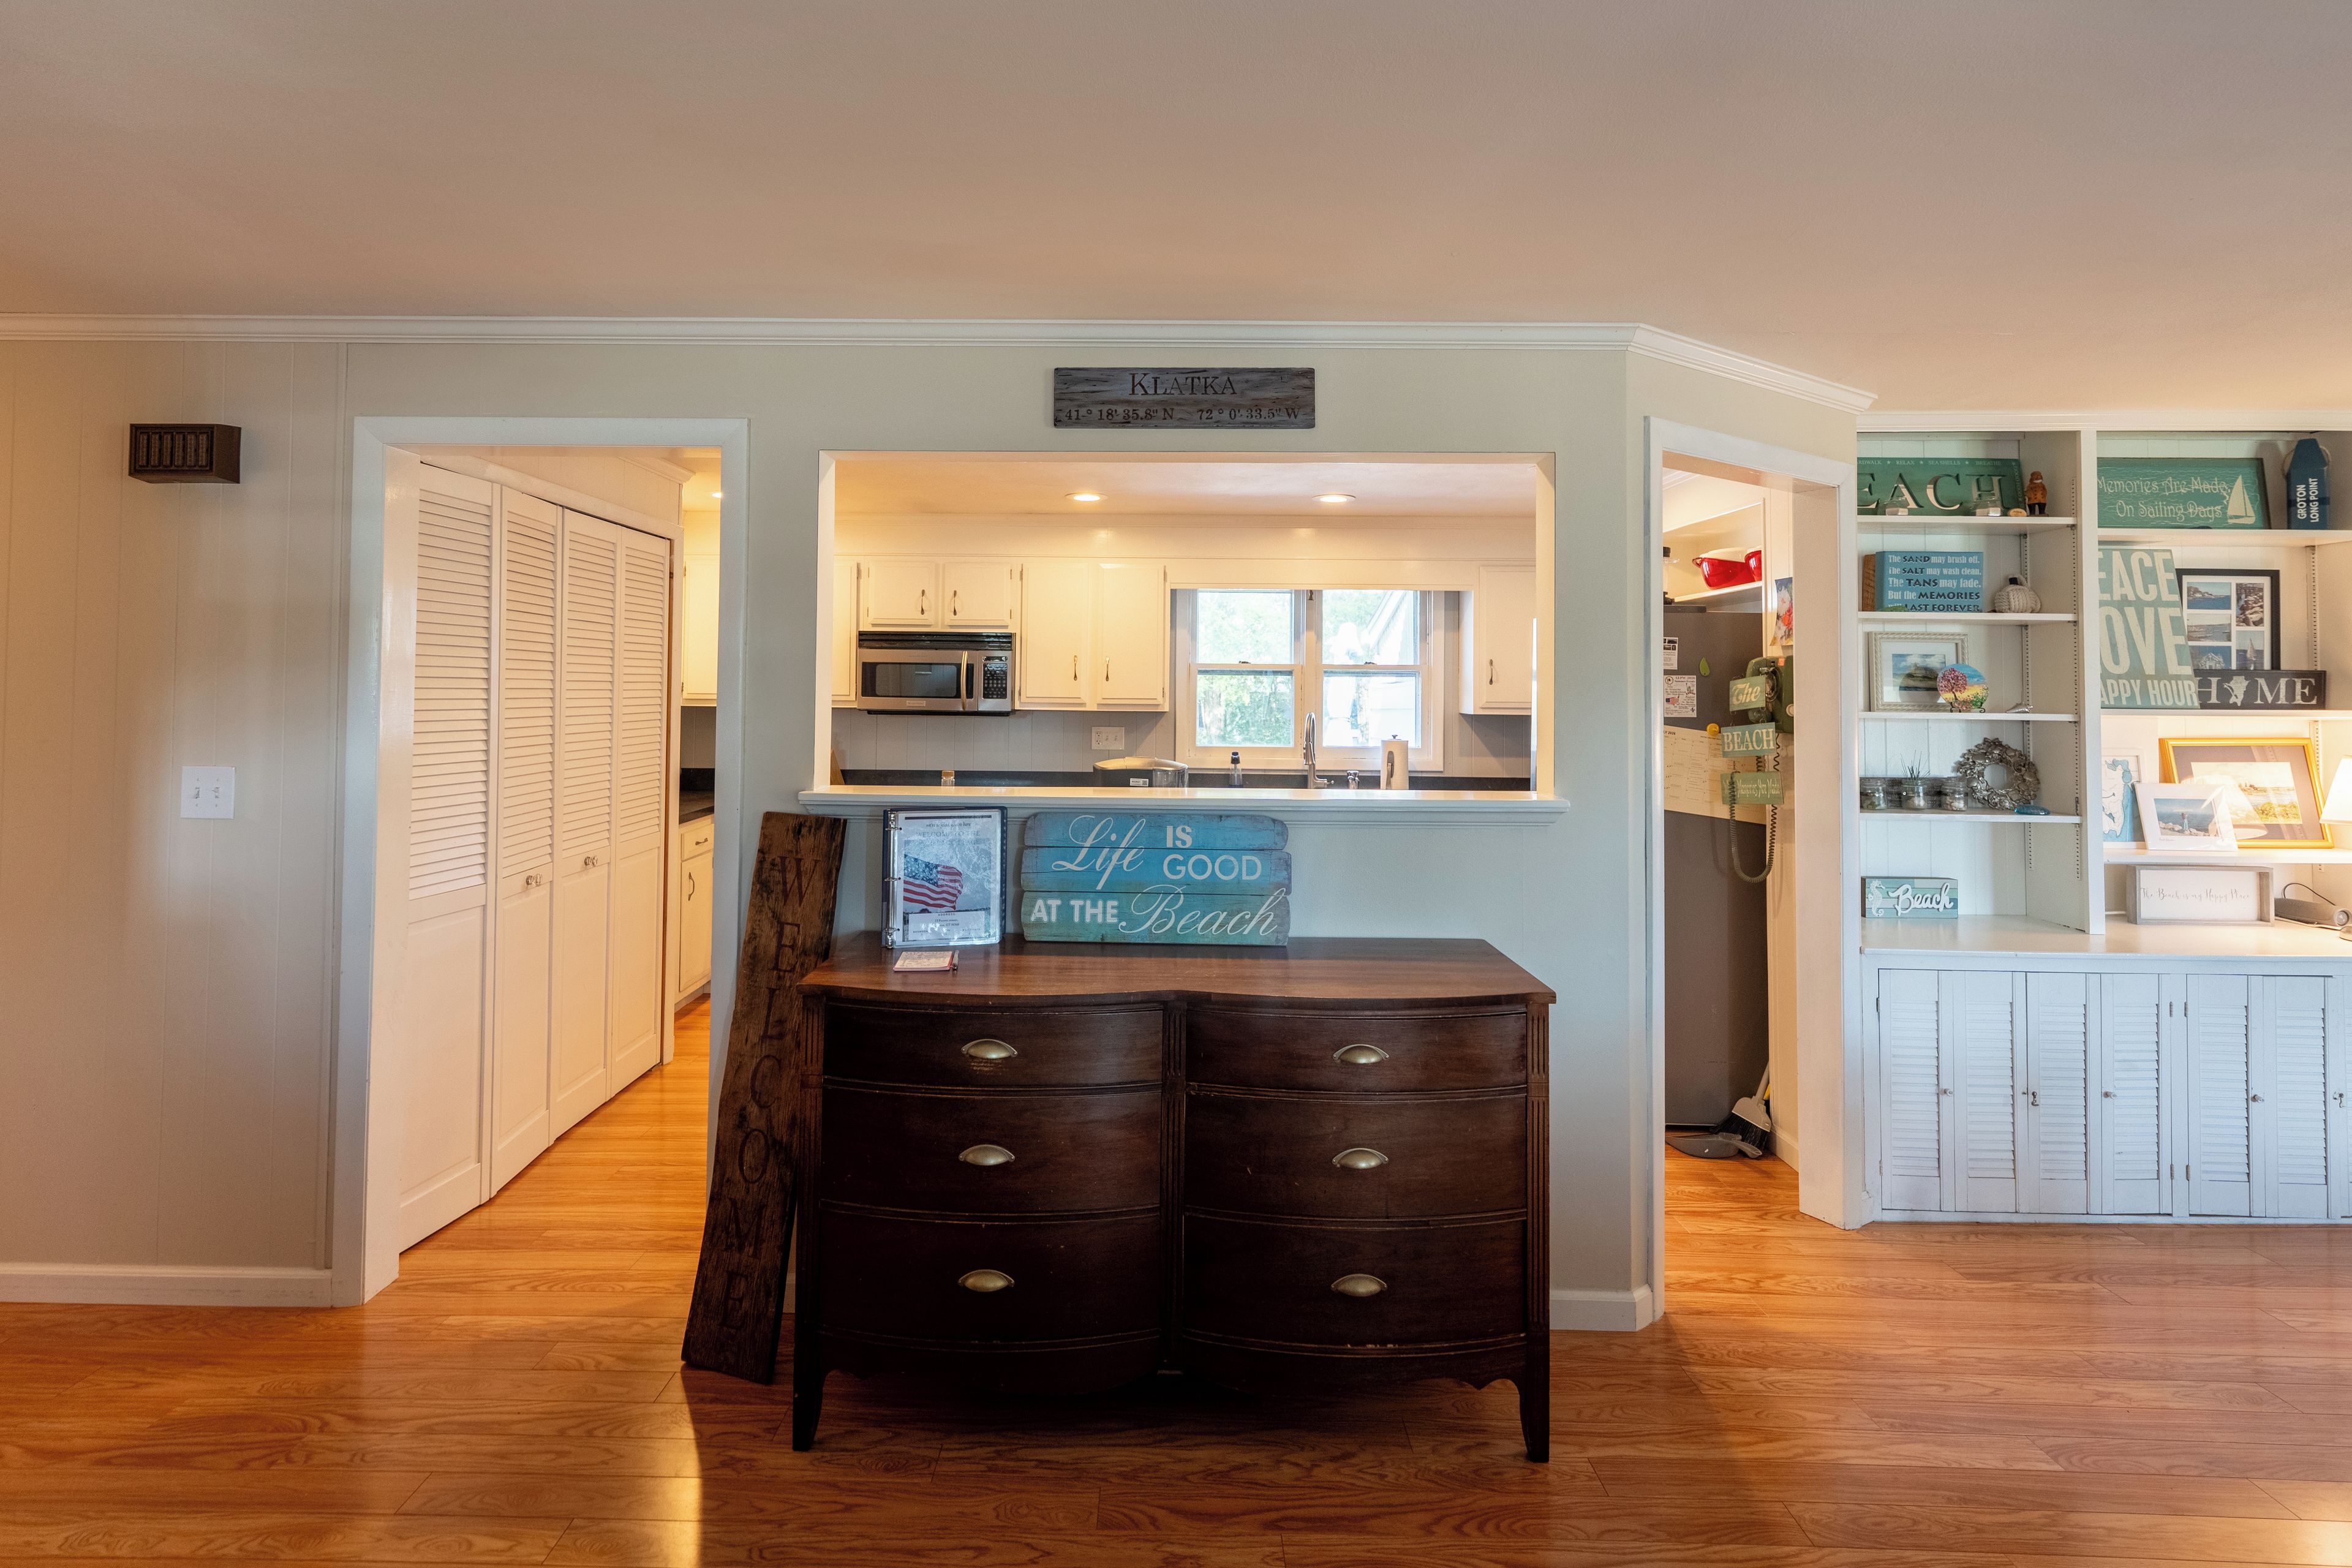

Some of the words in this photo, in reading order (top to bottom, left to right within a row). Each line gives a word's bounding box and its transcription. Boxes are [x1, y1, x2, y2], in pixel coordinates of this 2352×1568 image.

[1128, 372, 1237, 396] KLATKA
[1163, 409, 1175, 420] N
[1286, 408, 1300, 420] W
[2097, 476, 2159, 494] Memories
[2162, 477, 2187, 495] Are
[2309, 478, 2318, 500] POINT
[2116, 500, 2135, 517] On
[2138, 501, 2185, 522] Sailing
[2187, 501, 2223, 522] Days
[2296, 484, 2307, 519] GROTON
[2310, 501, 2320, 522] LONG
[1888, 554, 1901, 563] The
[1888, 578, 1904, 587] The
[1905, 578, 1938, 587] TANS
[1939, 579, 1958, 589] may
[1959, 578, 1981, 588] fade.
[1888, 590, 1902, 600] But
[1904, 590, 1917, 600] the
[1732, 682, 1761, 705] The
[2147, 679, 2199, 706] HOUR
[1723, 729, 1776, 752] BEACH
[1737, 779, 1758, 797] Memories
[1758, 779, 1767, 798] Are
[1767, 778, 1781, 799] Made
[1166, 825, 1193, 849] IS
[1051, 815, 1146, 891] Life
[1163, 854, 1262, 881] GOOD
[1887, 882, 1954, 916] Beach
[2141, 887, 2154, 900] The
[2156, 887, 2180, 901] Beach
[2204, 888, 2228, 903] Happy
[2228, 888, 2250, 900] Place
[1031, 899, 1061, 922] AT
[1069, 899, 1119, 924] THE
[1118, 884, 1287, 937] Beach
[717, 854, 821, 1331] WELCOME
